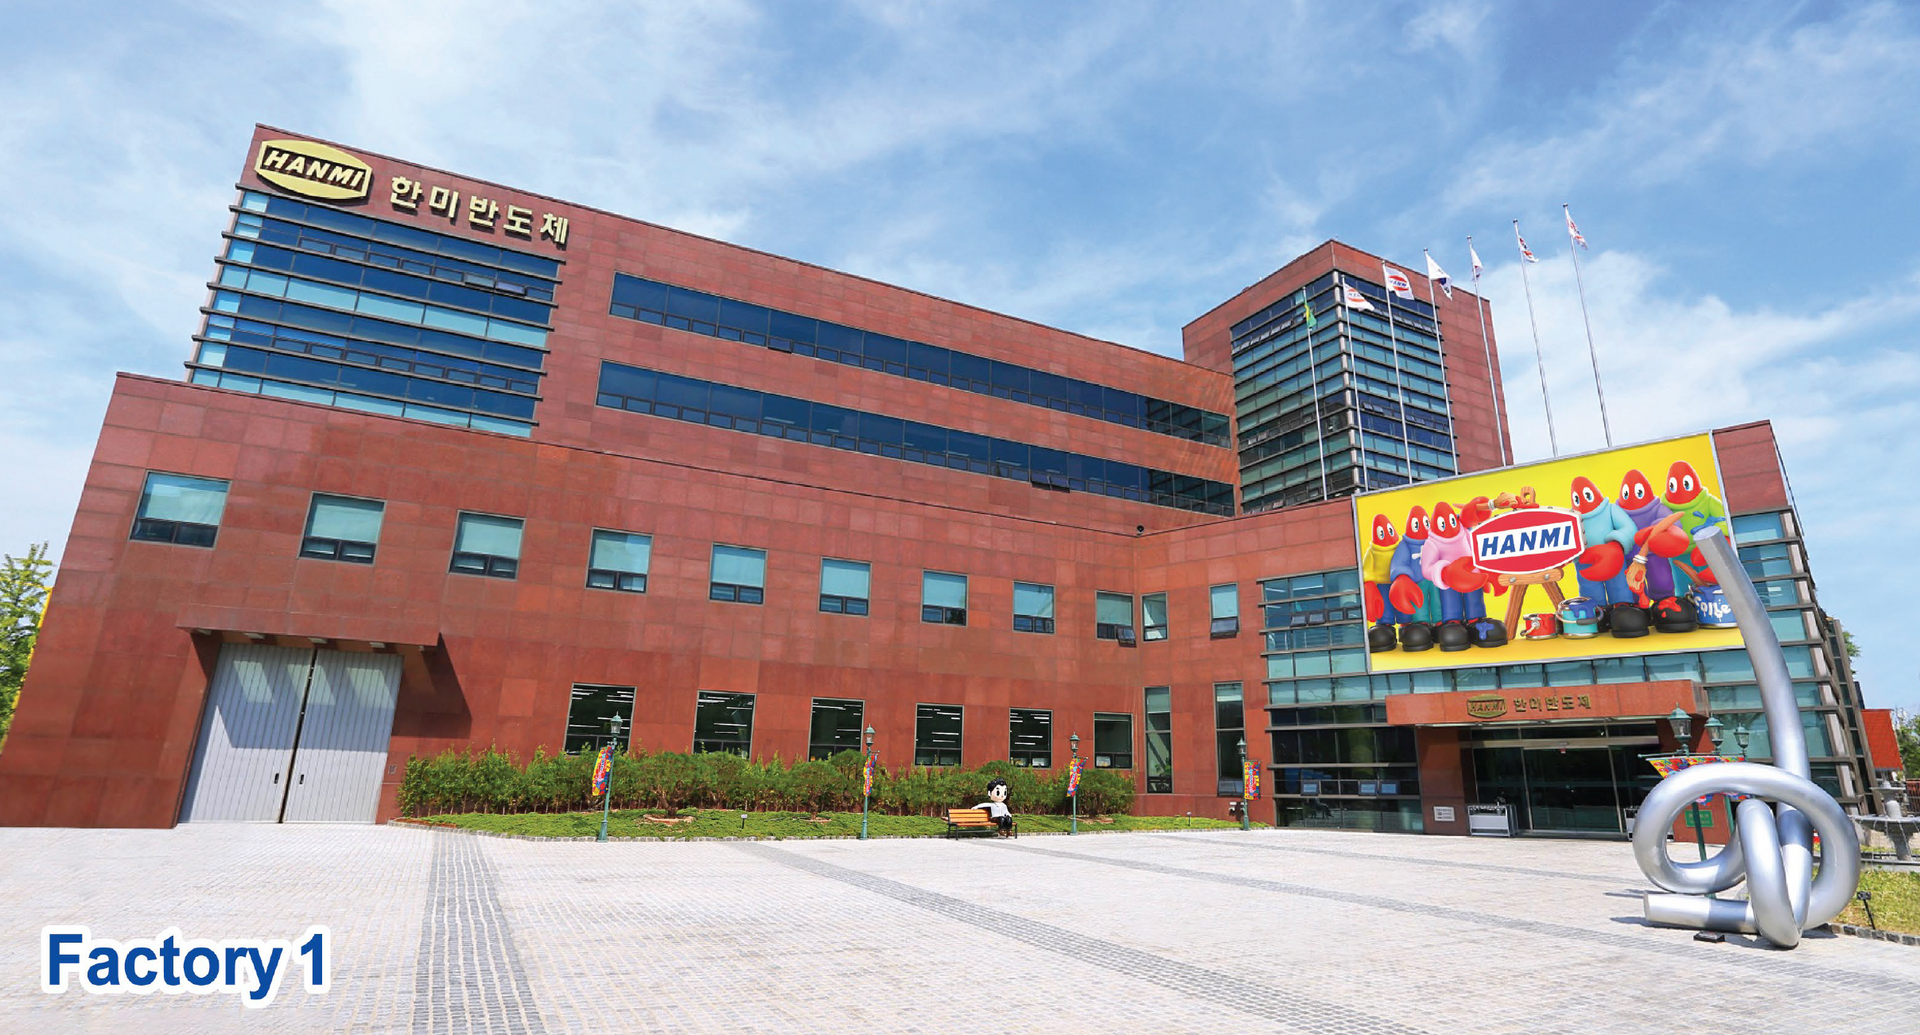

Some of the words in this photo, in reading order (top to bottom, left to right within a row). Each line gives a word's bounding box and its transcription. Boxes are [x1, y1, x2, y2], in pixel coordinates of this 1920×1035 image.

[263, 149, 365, 187] HANMI
[390, 176, 569, 245] 한미반도체
[1481, 525, 1572, 557] HANMI
